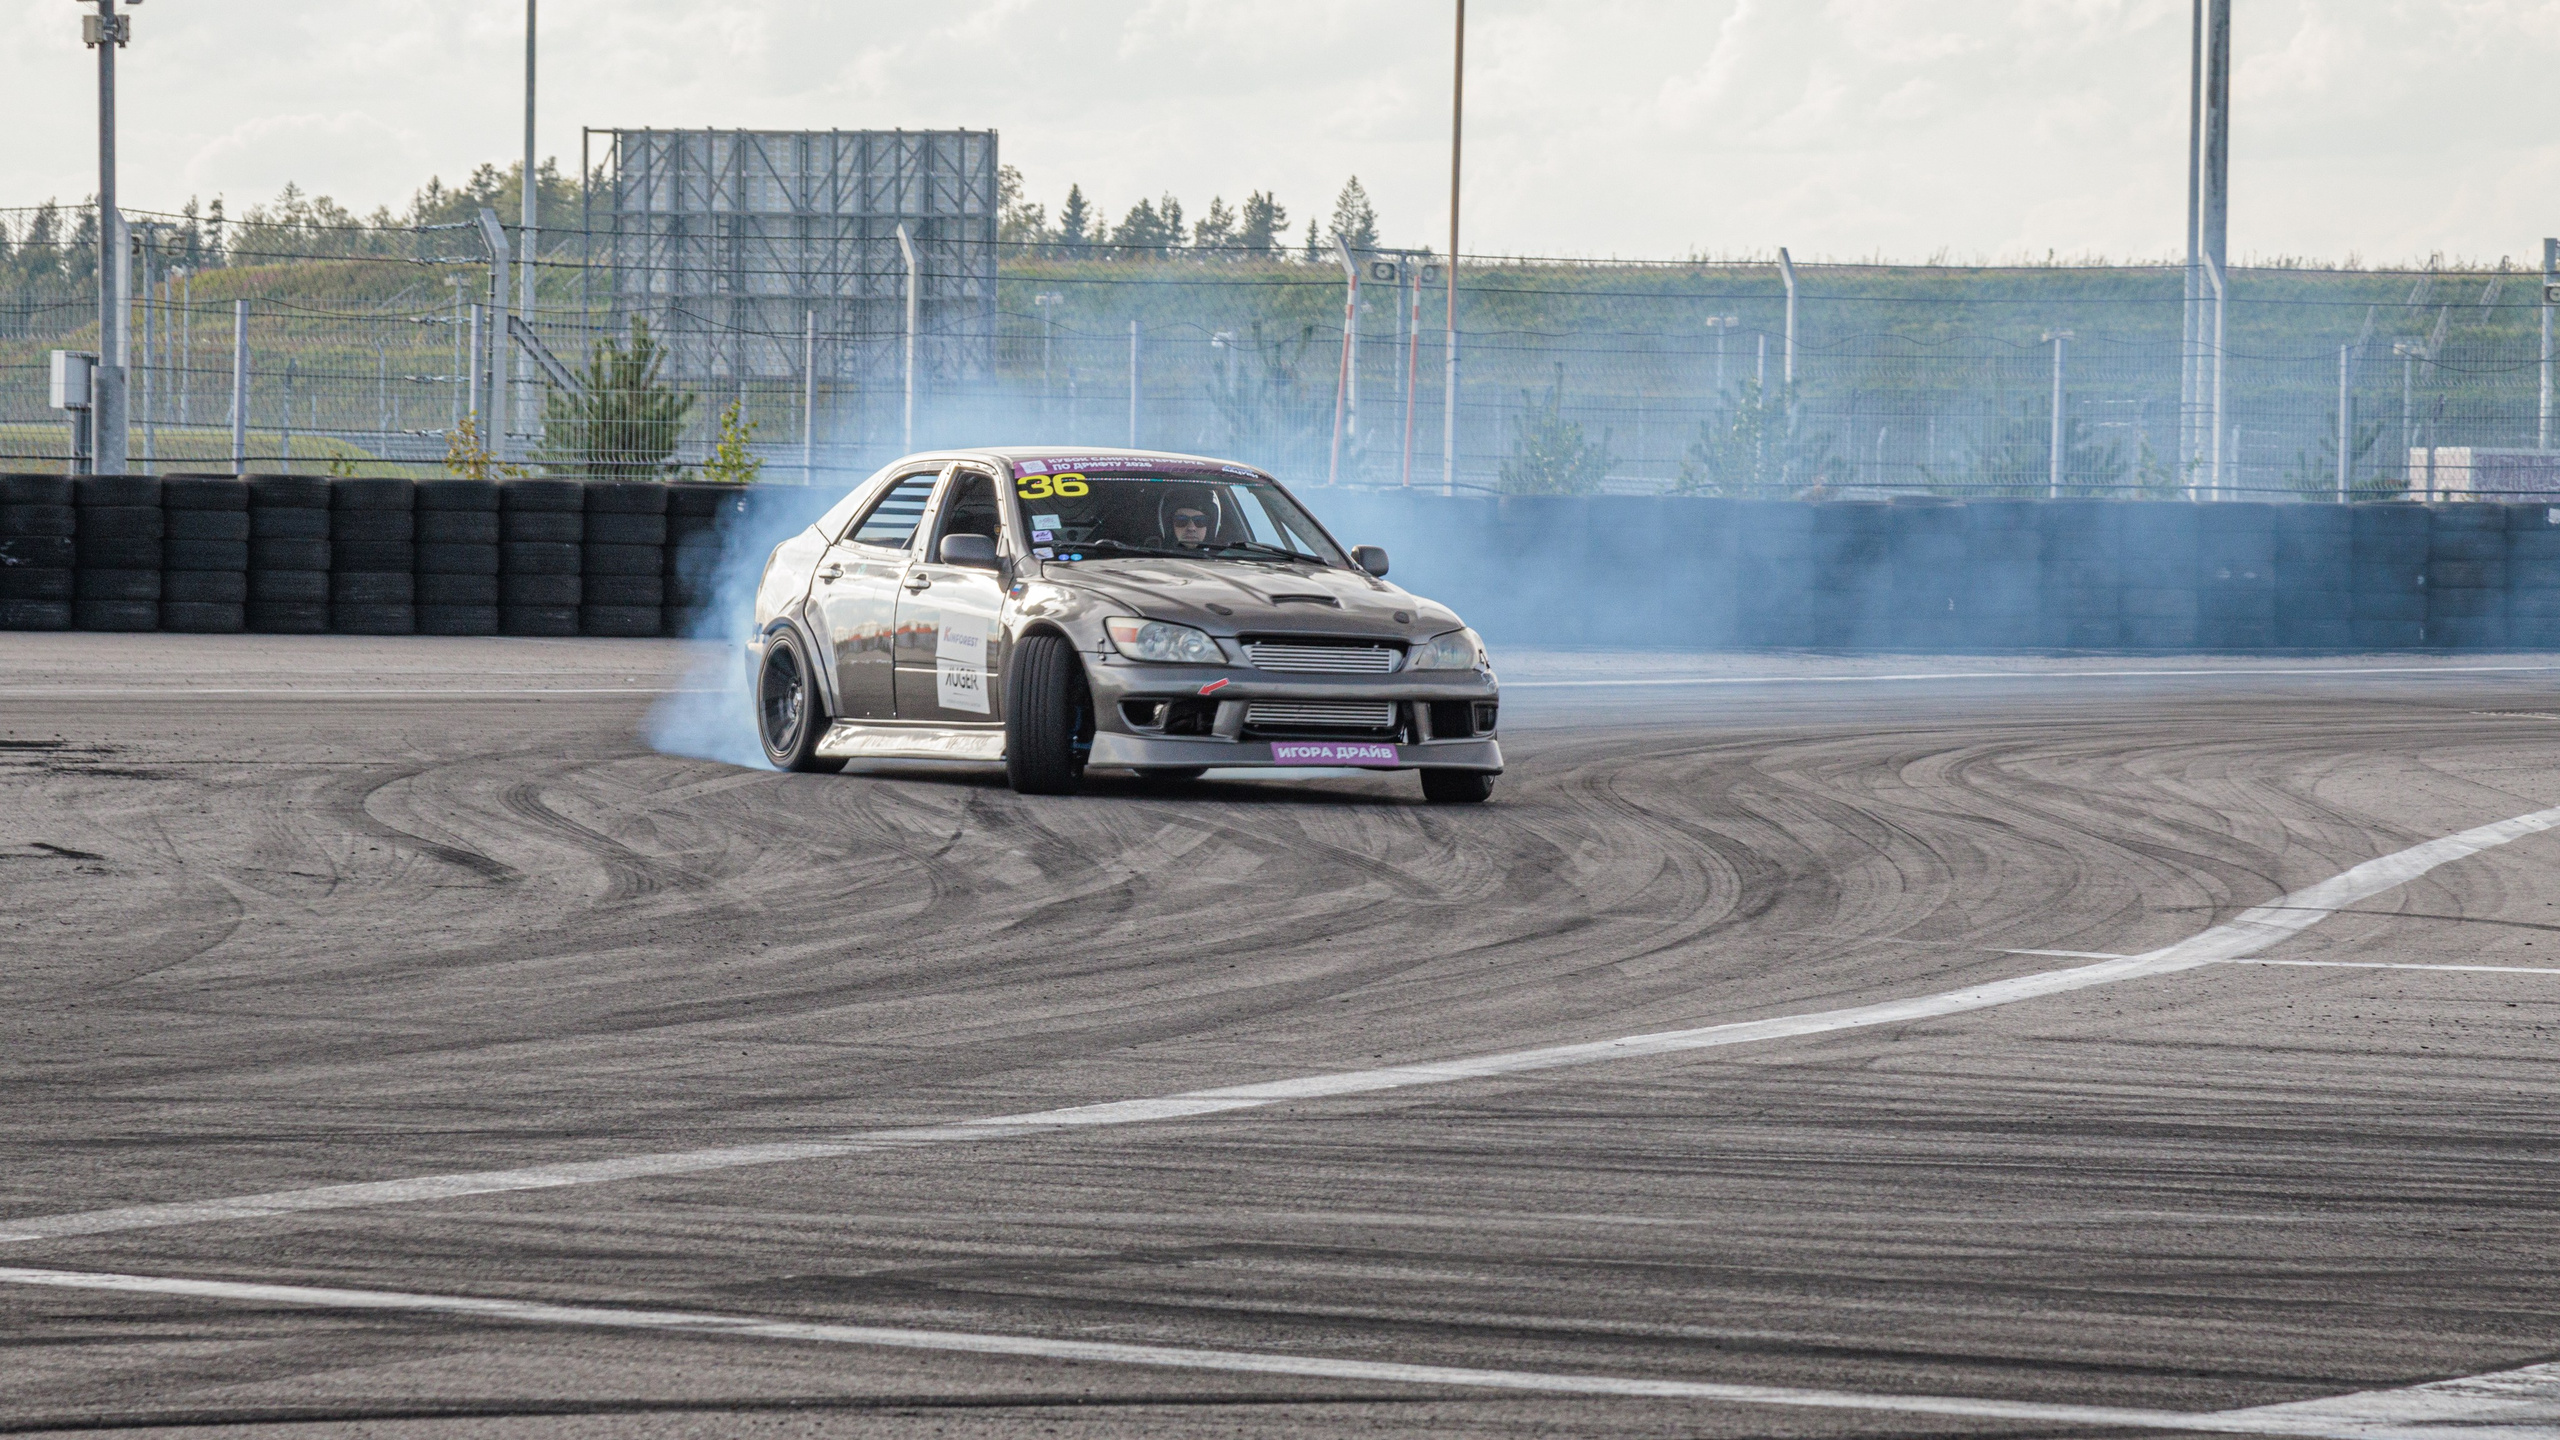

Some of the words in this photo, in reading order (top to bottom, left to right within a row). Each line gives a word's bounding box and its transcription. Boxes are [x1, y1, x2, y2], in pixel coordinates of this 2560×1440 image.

[1047, 456, 1089, 464] КУБОК
[1052, 463, 1071, 471] ПО
[1073, 461, 1121, 470] ДРИФТУ
[1017, 472, 1089, 499] 36
[1278, 746, 1334, 758] ИГОРА
[1336, 744, 1393, 760] ДРАЙВ
